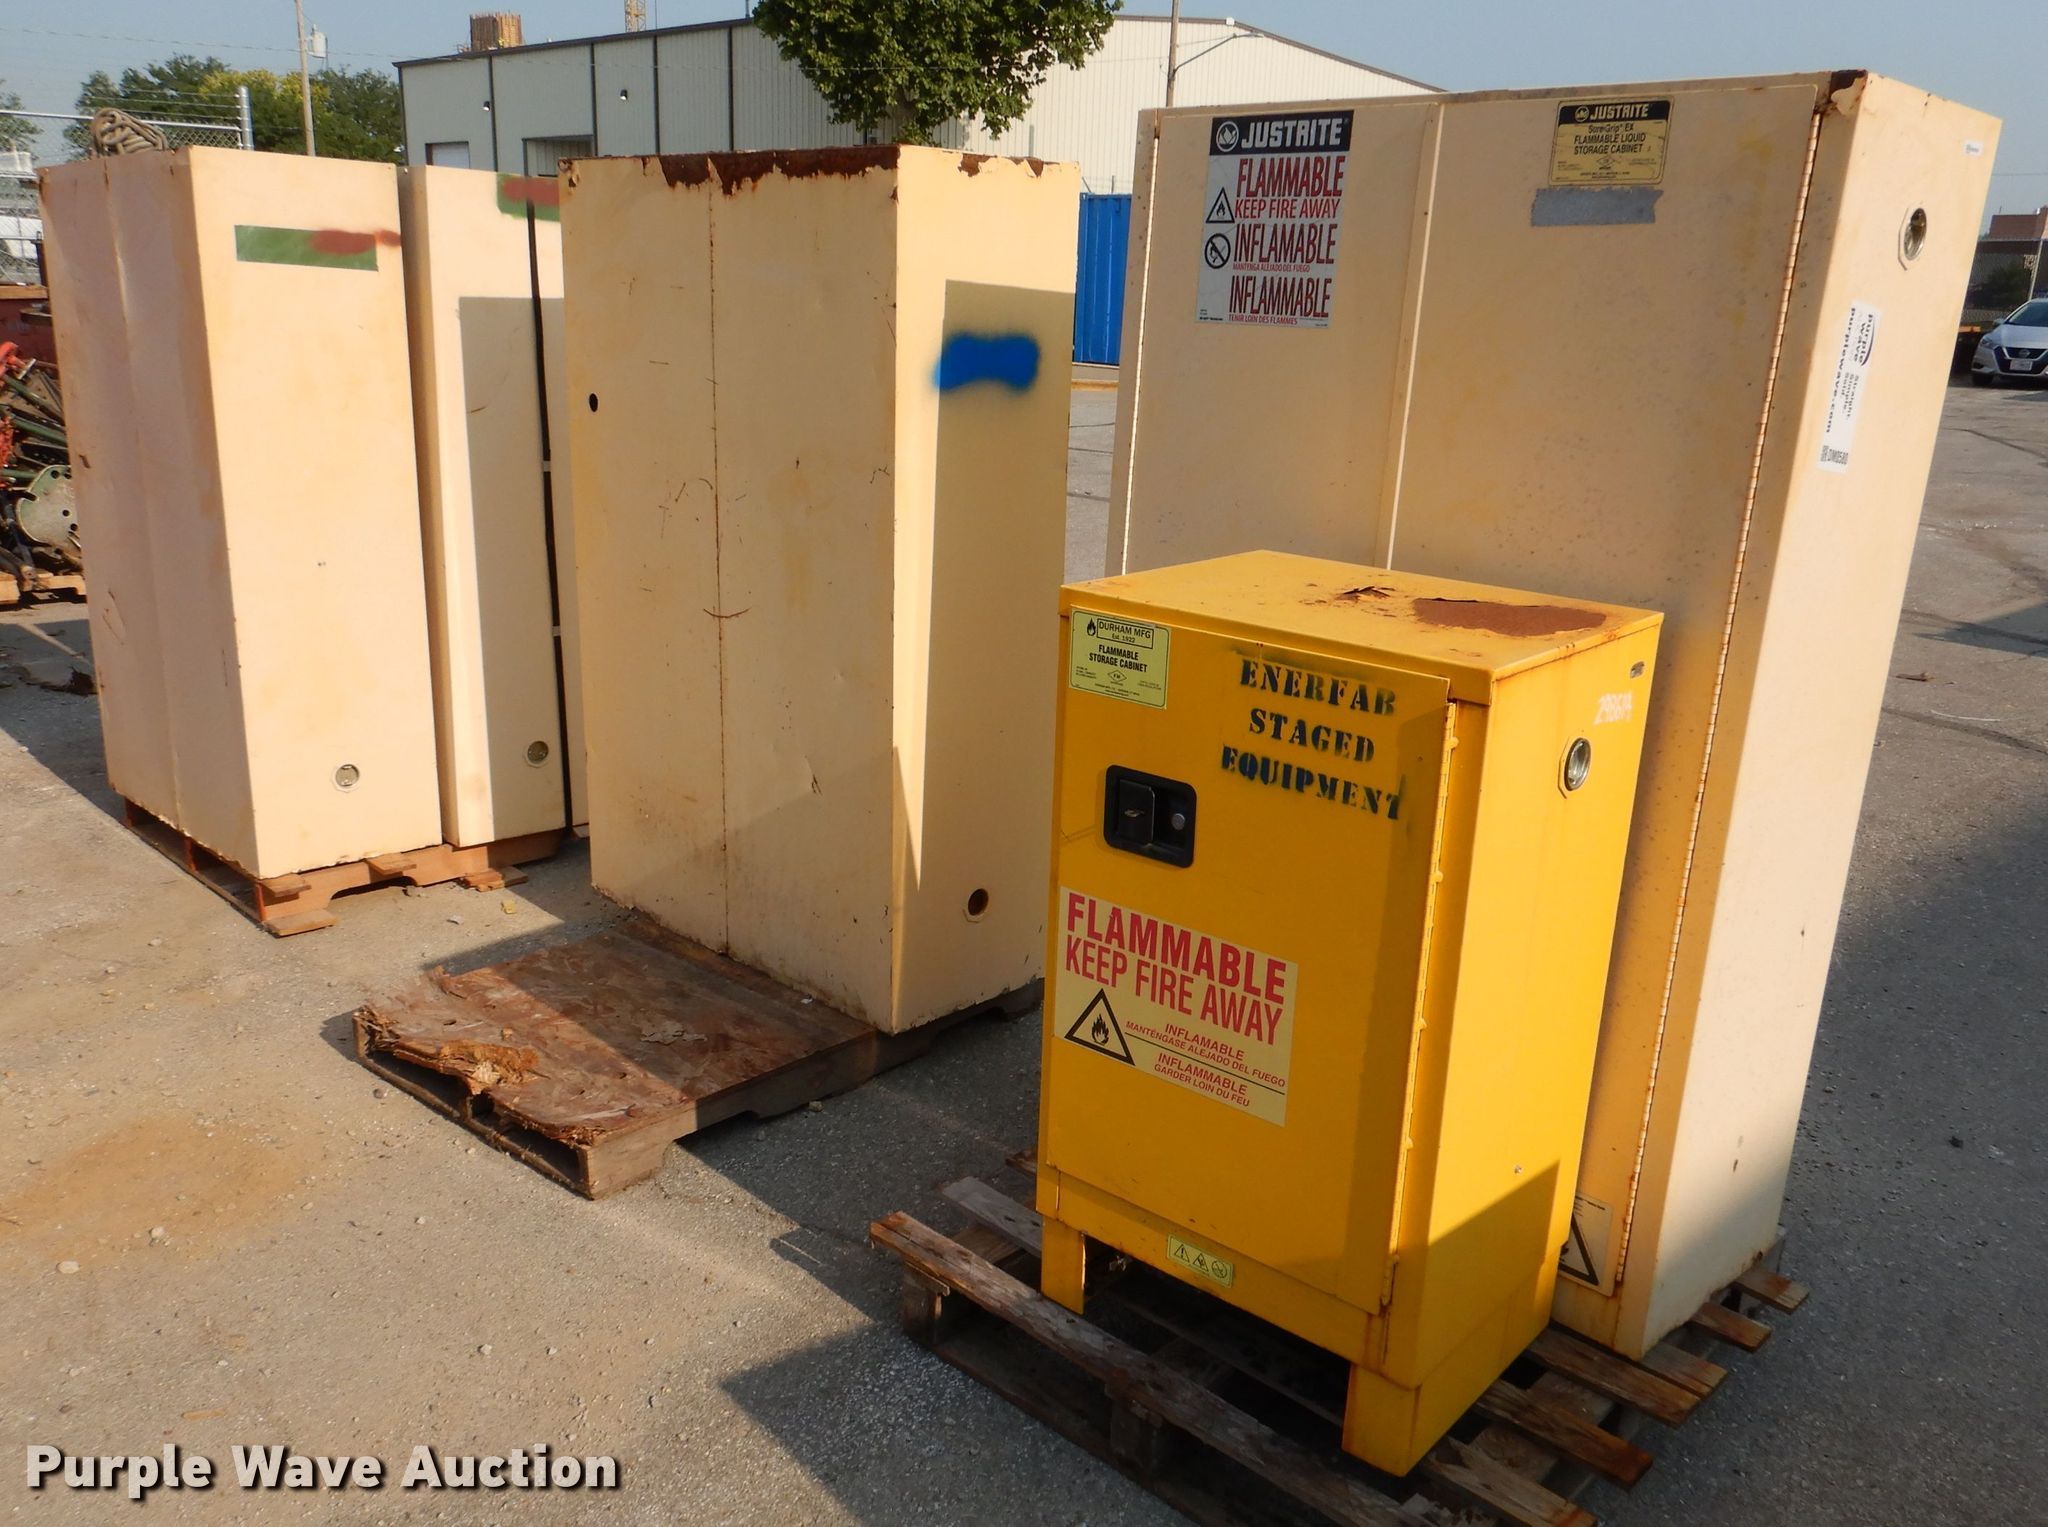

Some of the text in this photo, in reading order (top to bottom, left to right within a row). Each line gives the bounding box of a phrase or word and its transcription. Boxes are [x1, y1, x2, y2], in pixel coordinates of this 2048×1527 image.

[1590, 104, 1650, 120] JUSTRITE
[1241, 118, 1342, 148] JUSTRITE
[1574, 132, 1646, 144] FLAMMABLE LIQUID
[1574, 144, 1642, 155] STORAGE CABINET
[1236, 155, 1346, 198] FLAMMABLE
[1234, 198, 1340, 219] KEEP FIRE AWAY
[1234, 223, 1338, 264] INFLAMABLE
[1229, 275, 1332, 318] INFLAMMABLE
[1098, 622, 1151, 639] DURHAM MFG
[1089, 653, 1148, 672] STORAGE CABINET
[1098, 644, 1138, 660] FLAMMABLE
[1249, 708, 1375, 762] STAGED
[1221, 745, 1402, 820] EQUIPMENT
[1067, 892, 1287, 1005] FLAMMABLE
[1065, 934, 1284, 1046] KEEP FIRE AWAY
[1164, 1023, 1245, 1061] INFLAMABLE
[1154, 1064, 1250, 1107] GARDER LOIN DU FEU
[1158, 1052, 1248, 1096] INFLAMMABLE
[1188, 1042, 1230, 1066] ALEJADO
[1232, 1060, 1250, 1075] DEL
[1252, 1068, 1286, 1088] FUEGO
